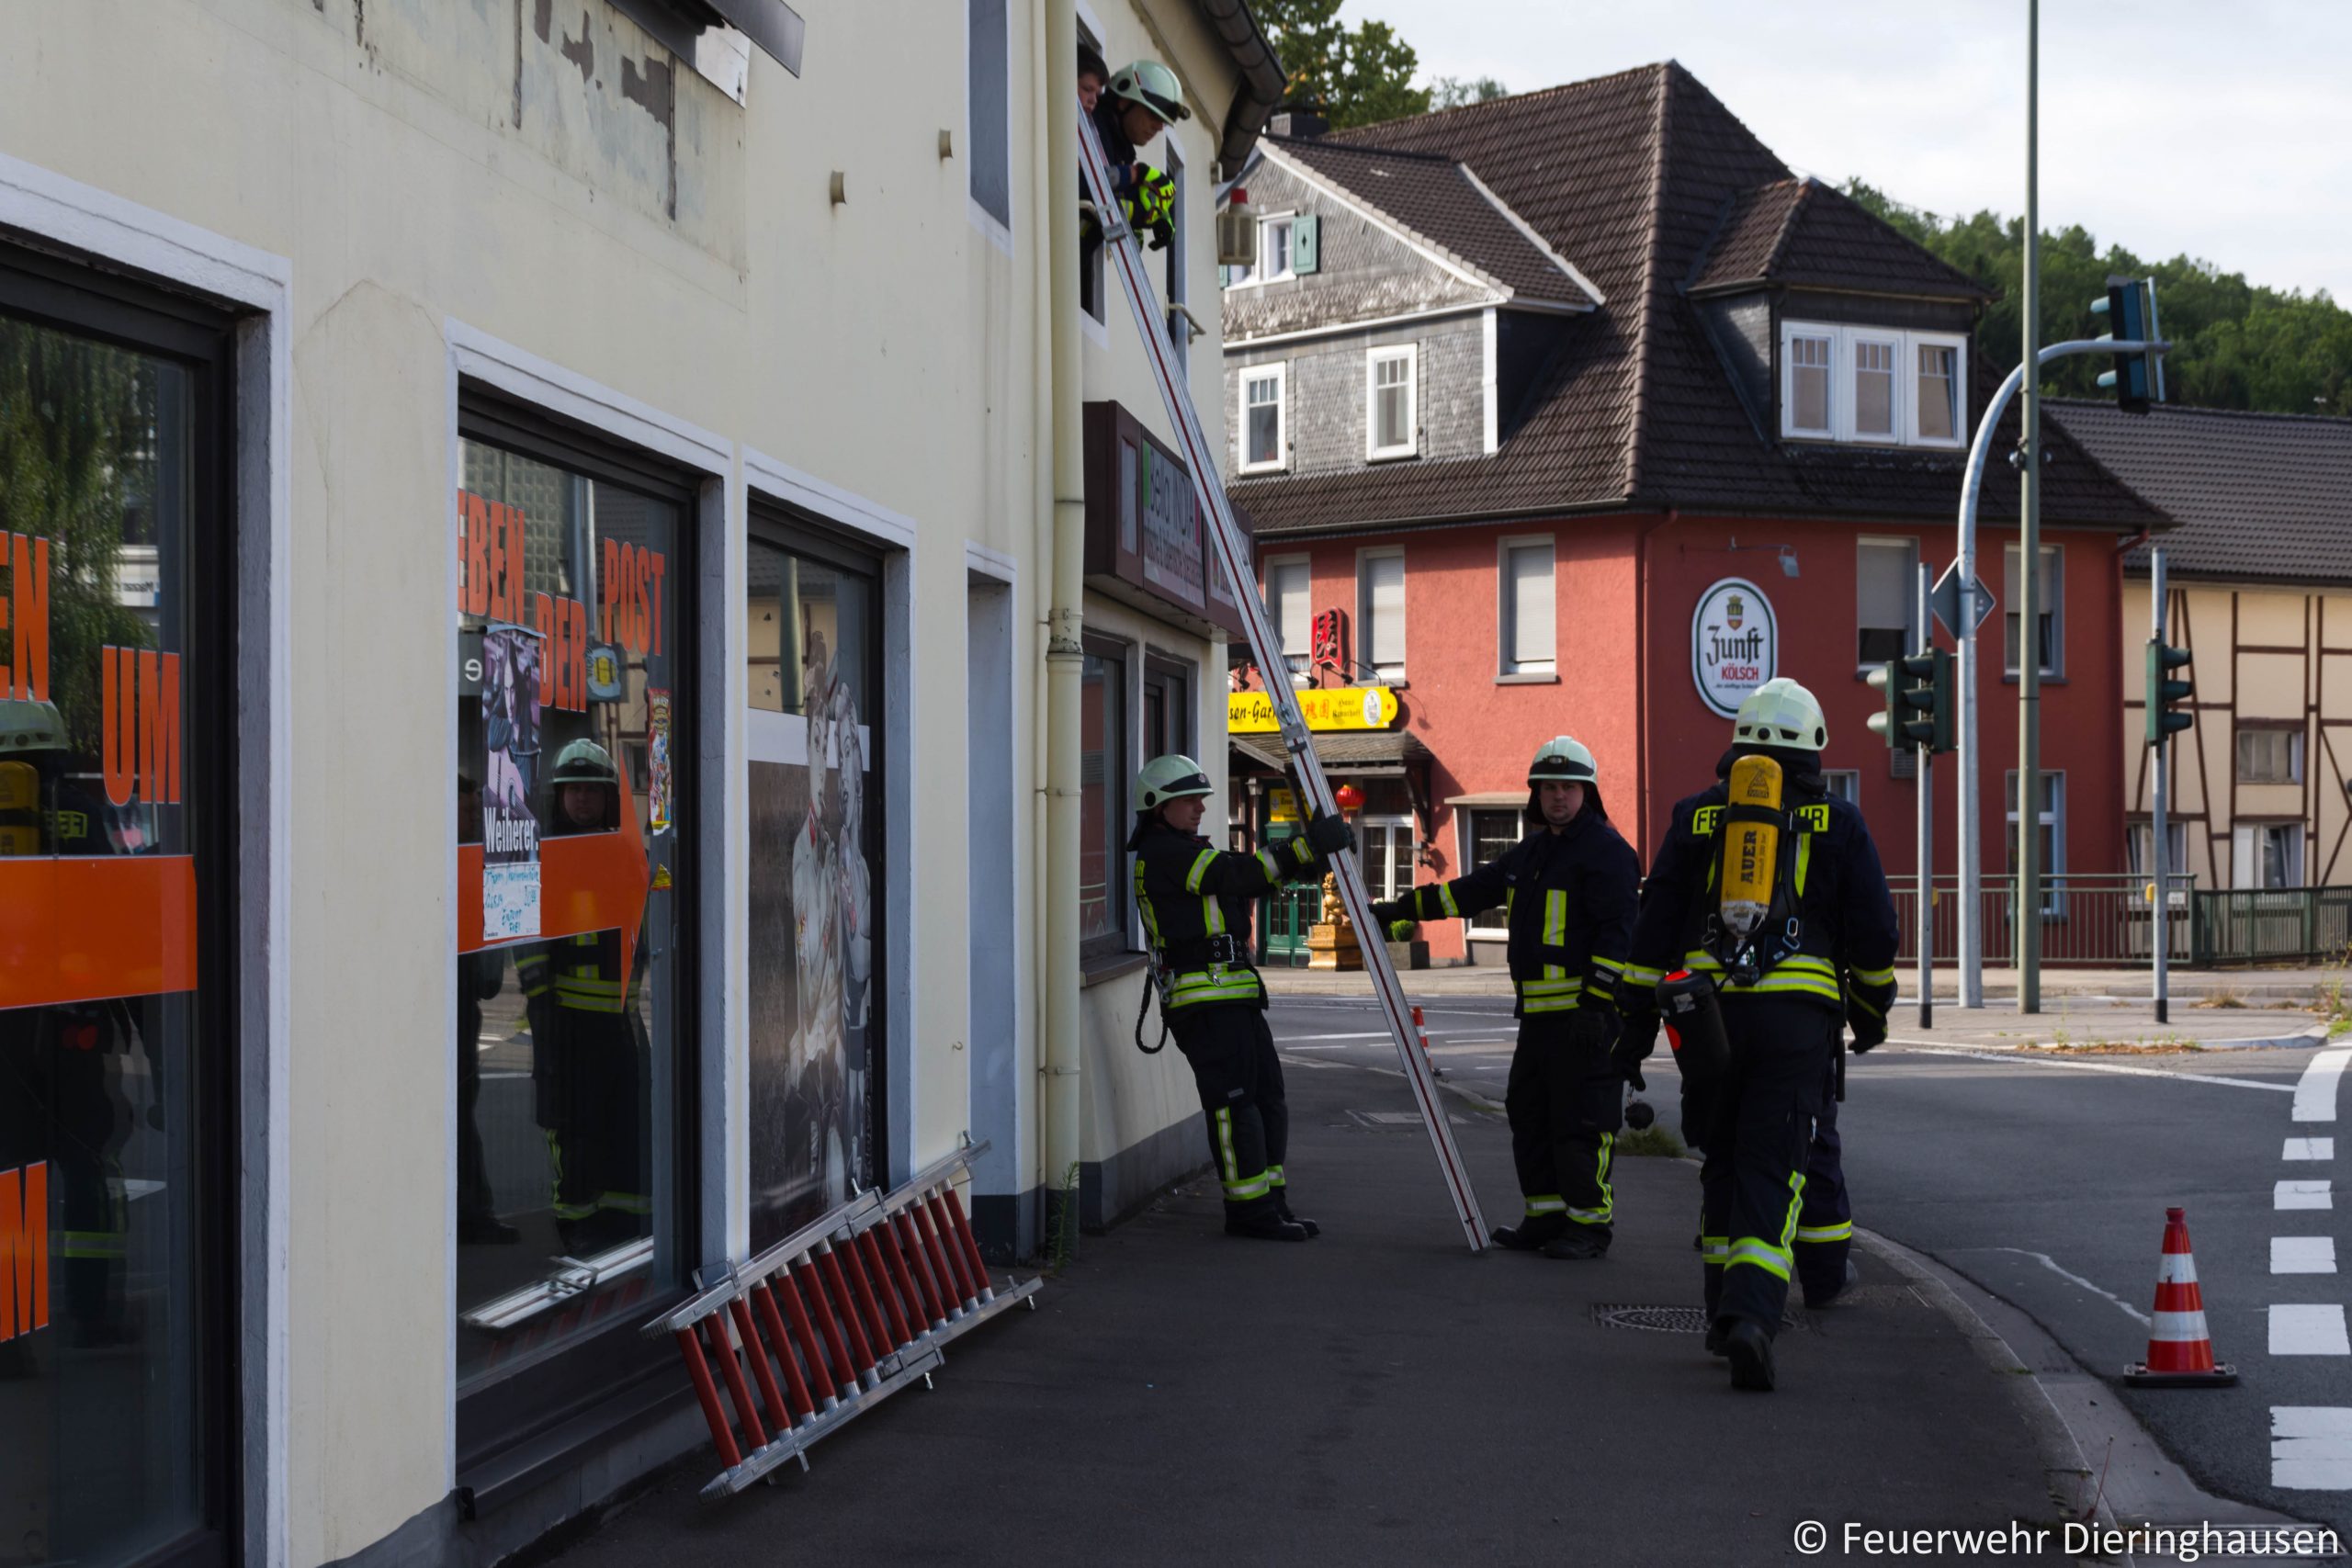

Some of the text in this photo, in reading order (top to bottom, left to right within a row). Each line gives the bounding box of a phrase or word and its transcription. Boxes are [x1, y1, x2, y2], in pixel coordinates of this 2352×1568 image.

[536, 591, 586, 713] DER
[605, 537, 665, 657] POST
[1705, 625, 1765, 667] Zunft
[1721, 663, 1759, 681] KÖLSCH
[103, 644, 180, 807] UM
[1229, 700, 1275, 723] sen-Gar
[484, 807, 539, 852] Weiherer.
[1741, 830, 1757, 884] AUER
